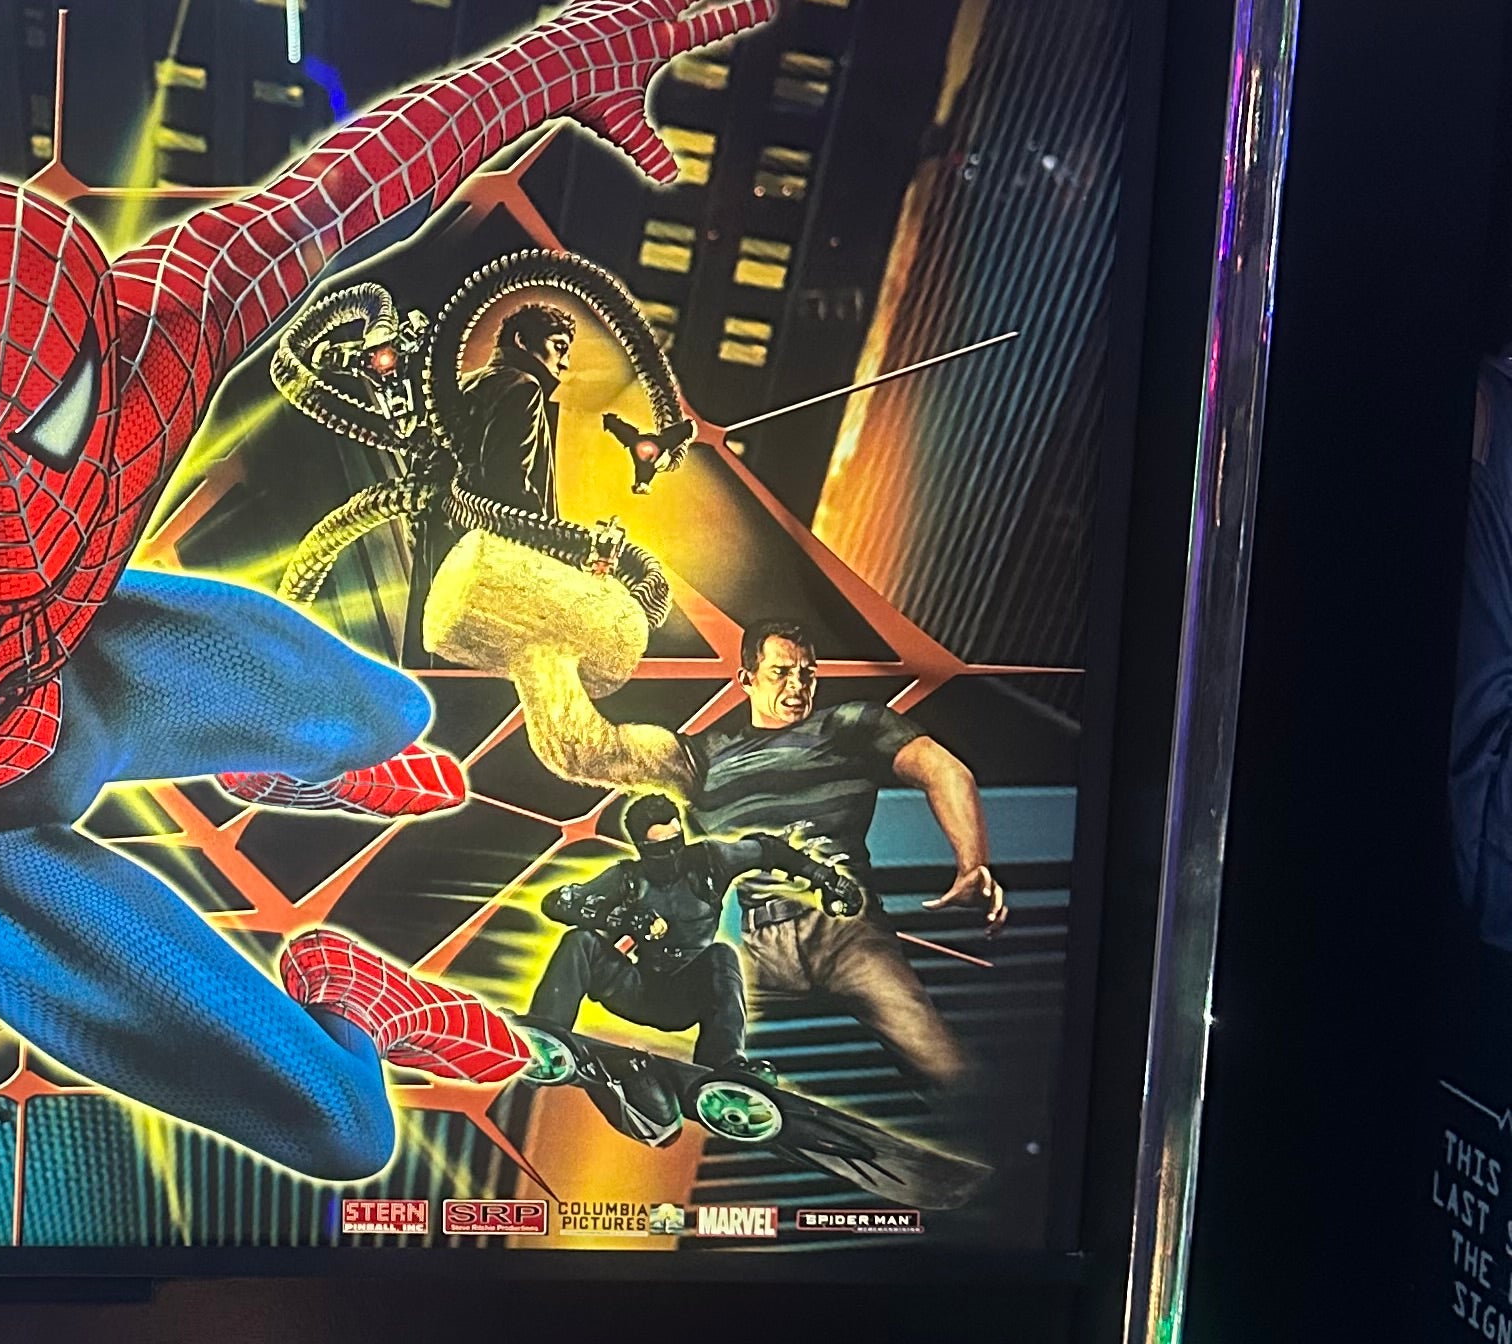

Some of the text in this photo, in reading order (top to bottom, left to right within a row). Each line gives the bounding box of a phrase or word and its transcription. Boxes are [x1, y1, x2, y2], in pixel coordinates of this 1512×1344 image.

[1445, 1129, 1501, 1198] THIS
[346, 1202, 424, 1222] STERN
[448, 1204, 542, 1224] SRP
[558, 1202, 648, 1216] COLUMBIA
[1432, 1170, 1490, 1235] LAST
[562, 1217, 646, 1231] PICTURES
[698, 1206, 777, 1236] MARVEL
[1451, 1229, 1494, 1290] THE
